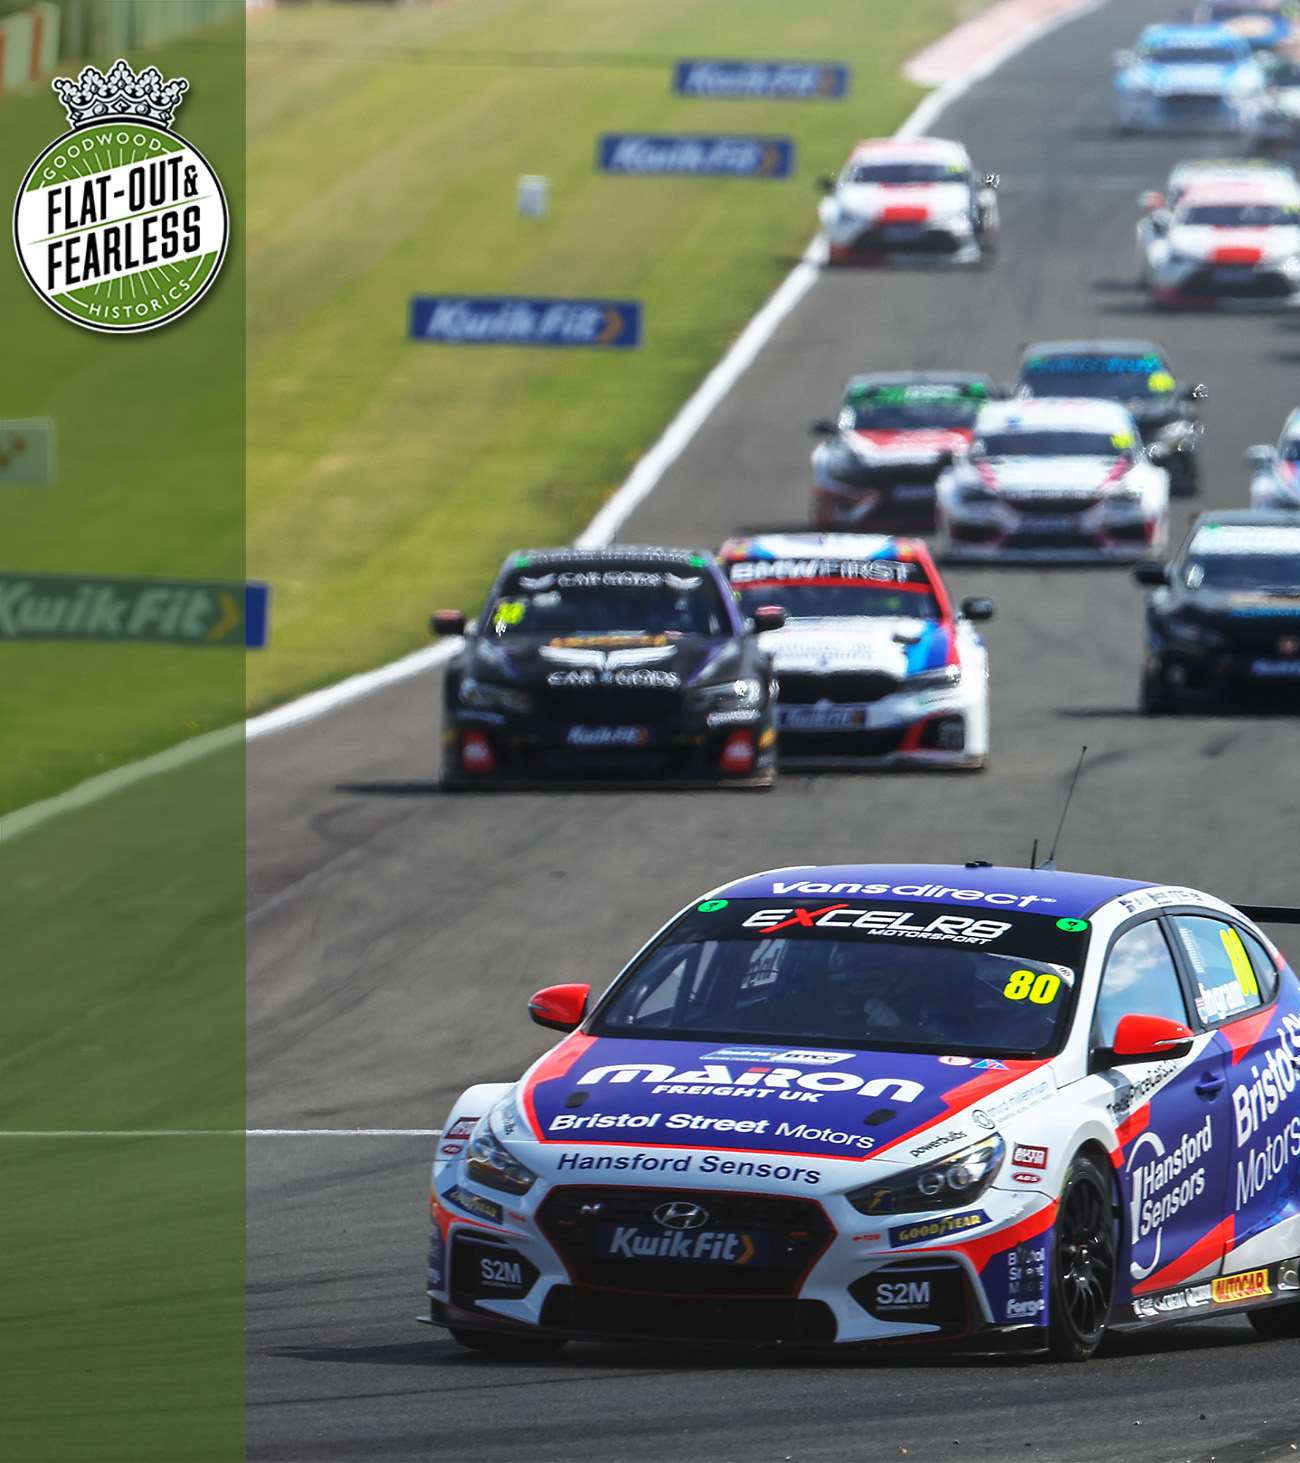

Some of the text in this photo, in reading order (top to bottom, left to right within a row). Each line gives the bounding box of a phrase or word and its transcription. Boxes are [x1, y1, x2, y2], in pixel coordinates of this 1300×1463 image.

[741, 903, 1013, 940] EXCELR8
[866, 927, 993, 946] MOTORSPORT
[1003, 968, 1061, 1005] 80
[651, 1084, 824, 1103] FREIGHT UK
[549, 1113, 876, 1149] Bristol Street Motors
[909, 1129, 968, 1159] powerbulbs
[557, 1153, 822, 1185] Hansford Sensors
[1142, 1114, 1213, 1200] Hansford
[1140, 1166, 1206, 1238] Sensors
[480, 1258, 523, 1284] S2M
[876, 1281, 931, 1305] S2M
